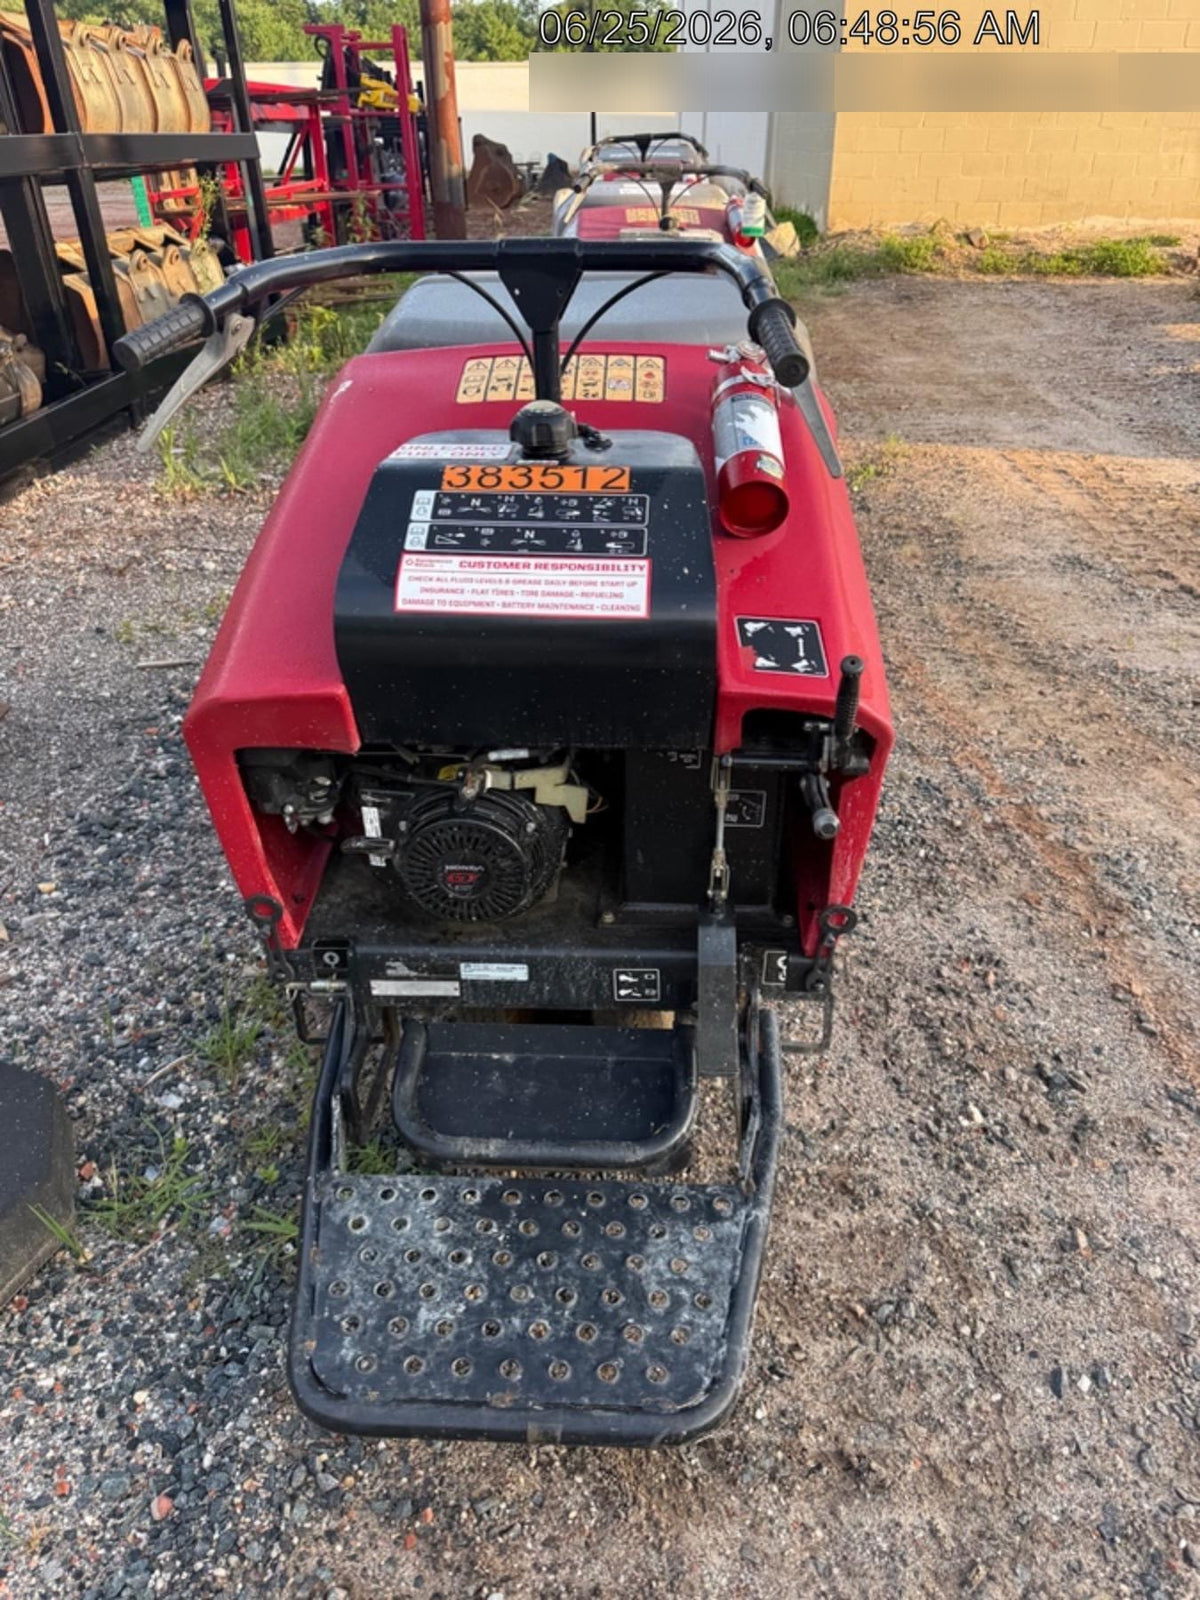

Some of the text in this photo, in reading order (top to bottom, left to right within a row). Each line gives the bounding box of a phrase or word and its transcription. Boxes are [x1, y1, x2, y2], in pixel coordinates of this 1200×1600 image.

[446, 465, 626, 489] 383512
[470, 498, 481, 506] N
[524, 530, 535, 538] N
[459, 559, 646, 572] CUSTOMER RESPONSIBILITY
[568, 579, 598, 587] BEFORE
[420, 587, 465, 595] INSURANCE
[580, 591, 625, 599] REFUELING
[401, 598, 435, 606] DAMAGE
[448, 600, 496, 608] EQUIPMENT
[501, 601, 536, 609] BATTERY
[537, 603, 595, 611] MAINTENANCE
[600, 604, 641, 612] CLEANING
